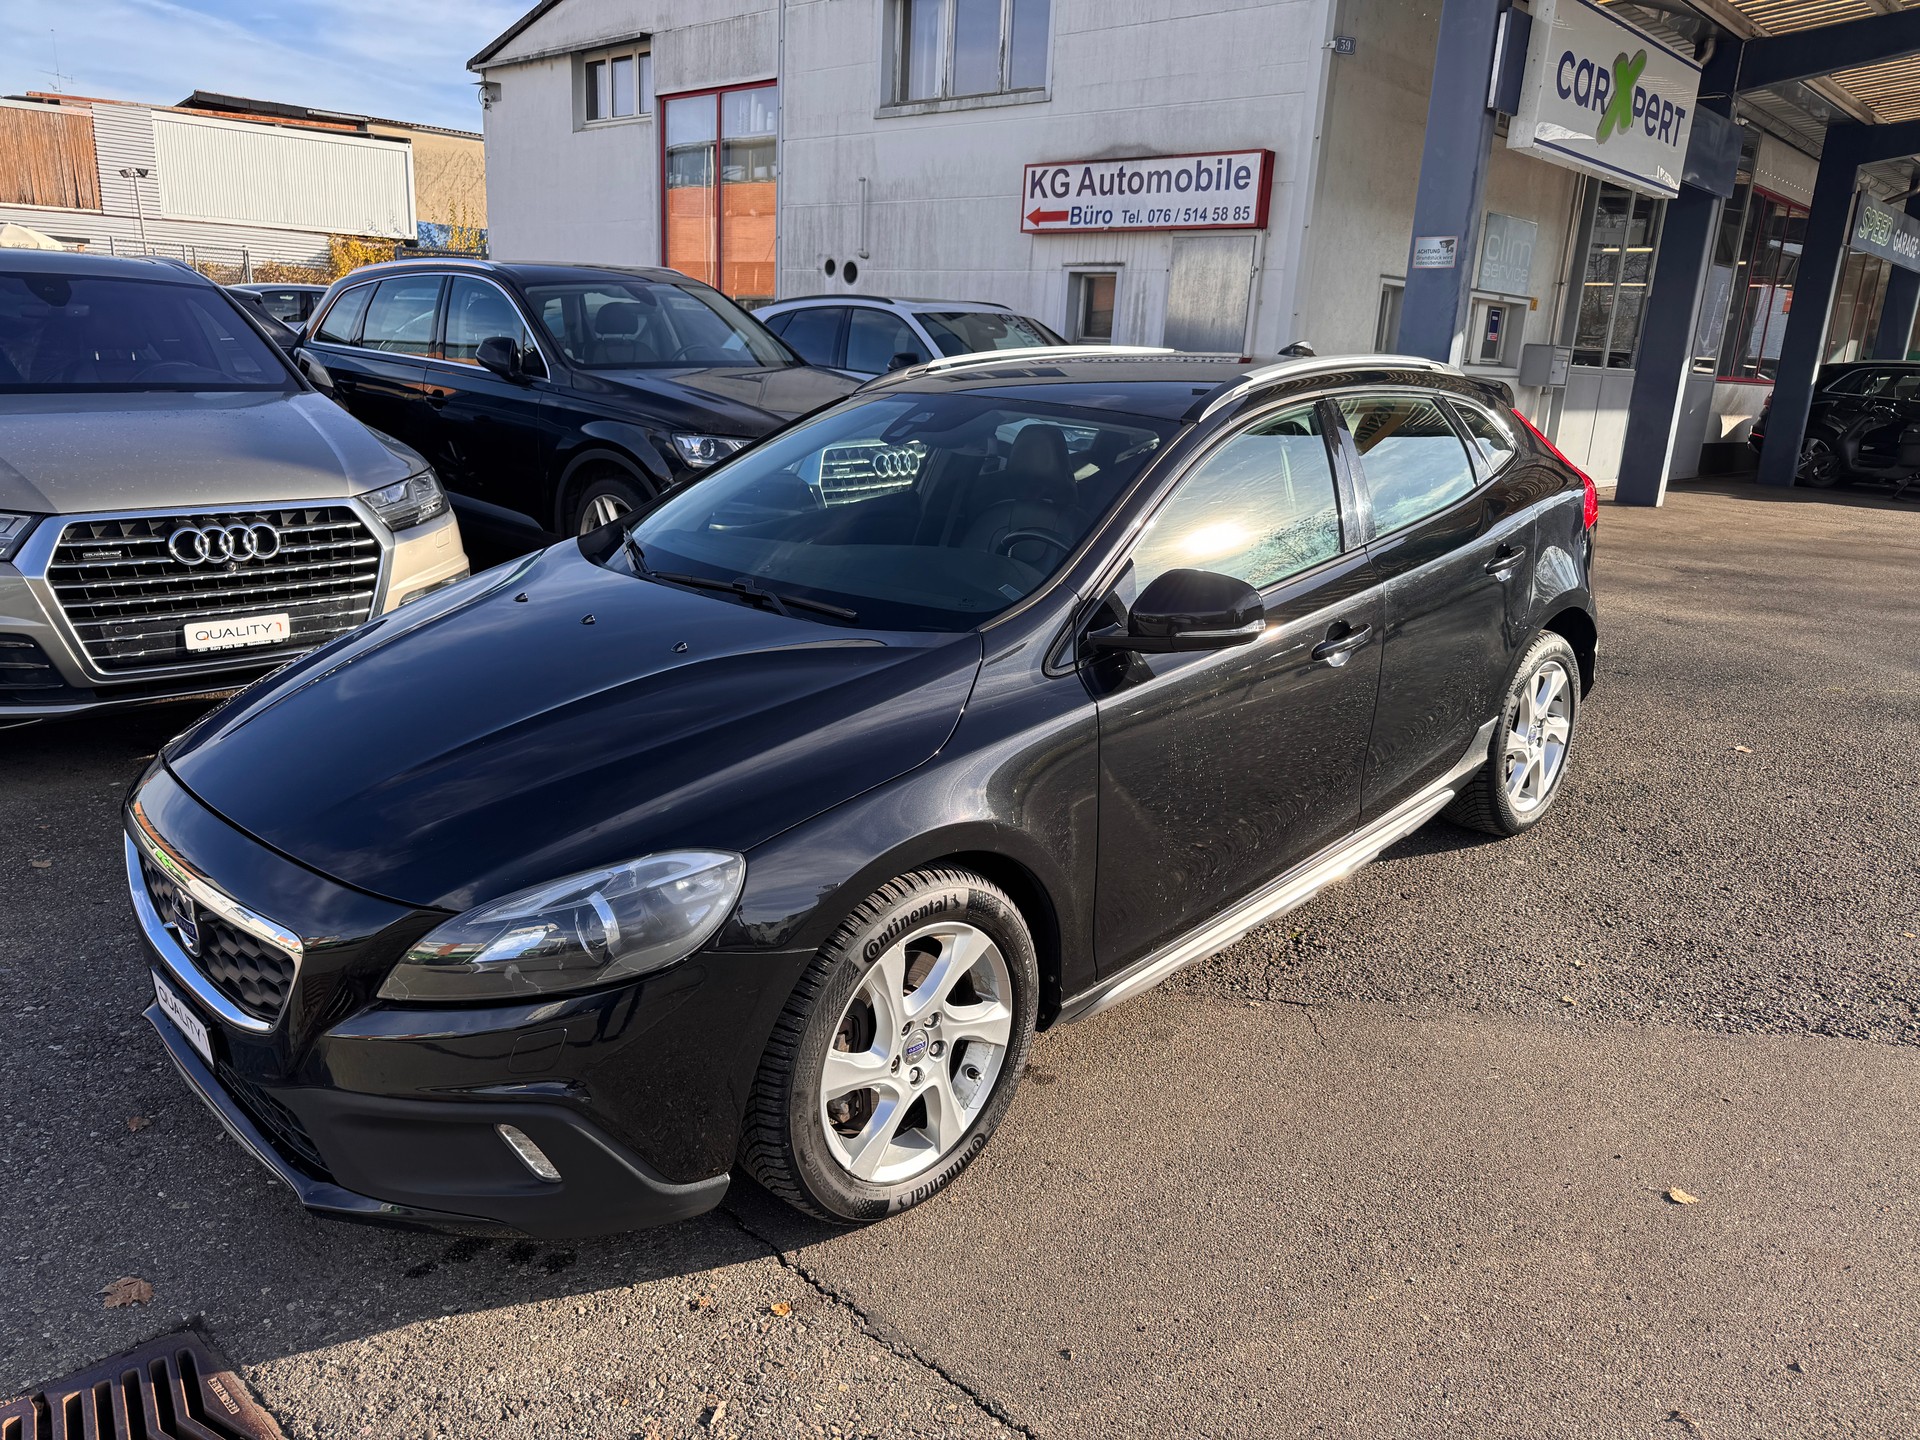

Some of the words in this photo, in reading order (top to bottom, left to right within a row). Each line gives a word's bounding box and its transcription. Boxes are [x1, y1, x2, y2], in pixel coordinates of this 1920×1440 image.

[1029, 168, 1071, 199] KG
[1076, 158, 1251, 197] Automobile
[1069, 206, 1113, 226] Büro
[1122, 209, 1143, 223] Tel.
[1147, 208, 1171, 223] 076
[1174, 207, 1180, 223] /
[1183, 207, 1207, 223] 514
[1211, 206, 1229, 222] 58
[1233, 205, 1250, 221] 85
[1858, 206, 1894, 247] SPEED
[1893, 229, 1919, 259] GARAGE
[1481, 261, 1529, 283] service
[195, 622, 273, 641] QUALITY
[862, 894, 949, 963] Continental
[158, 985, 201, 1042] QUALITY
[910, 1132, 987, 1208] Continental
